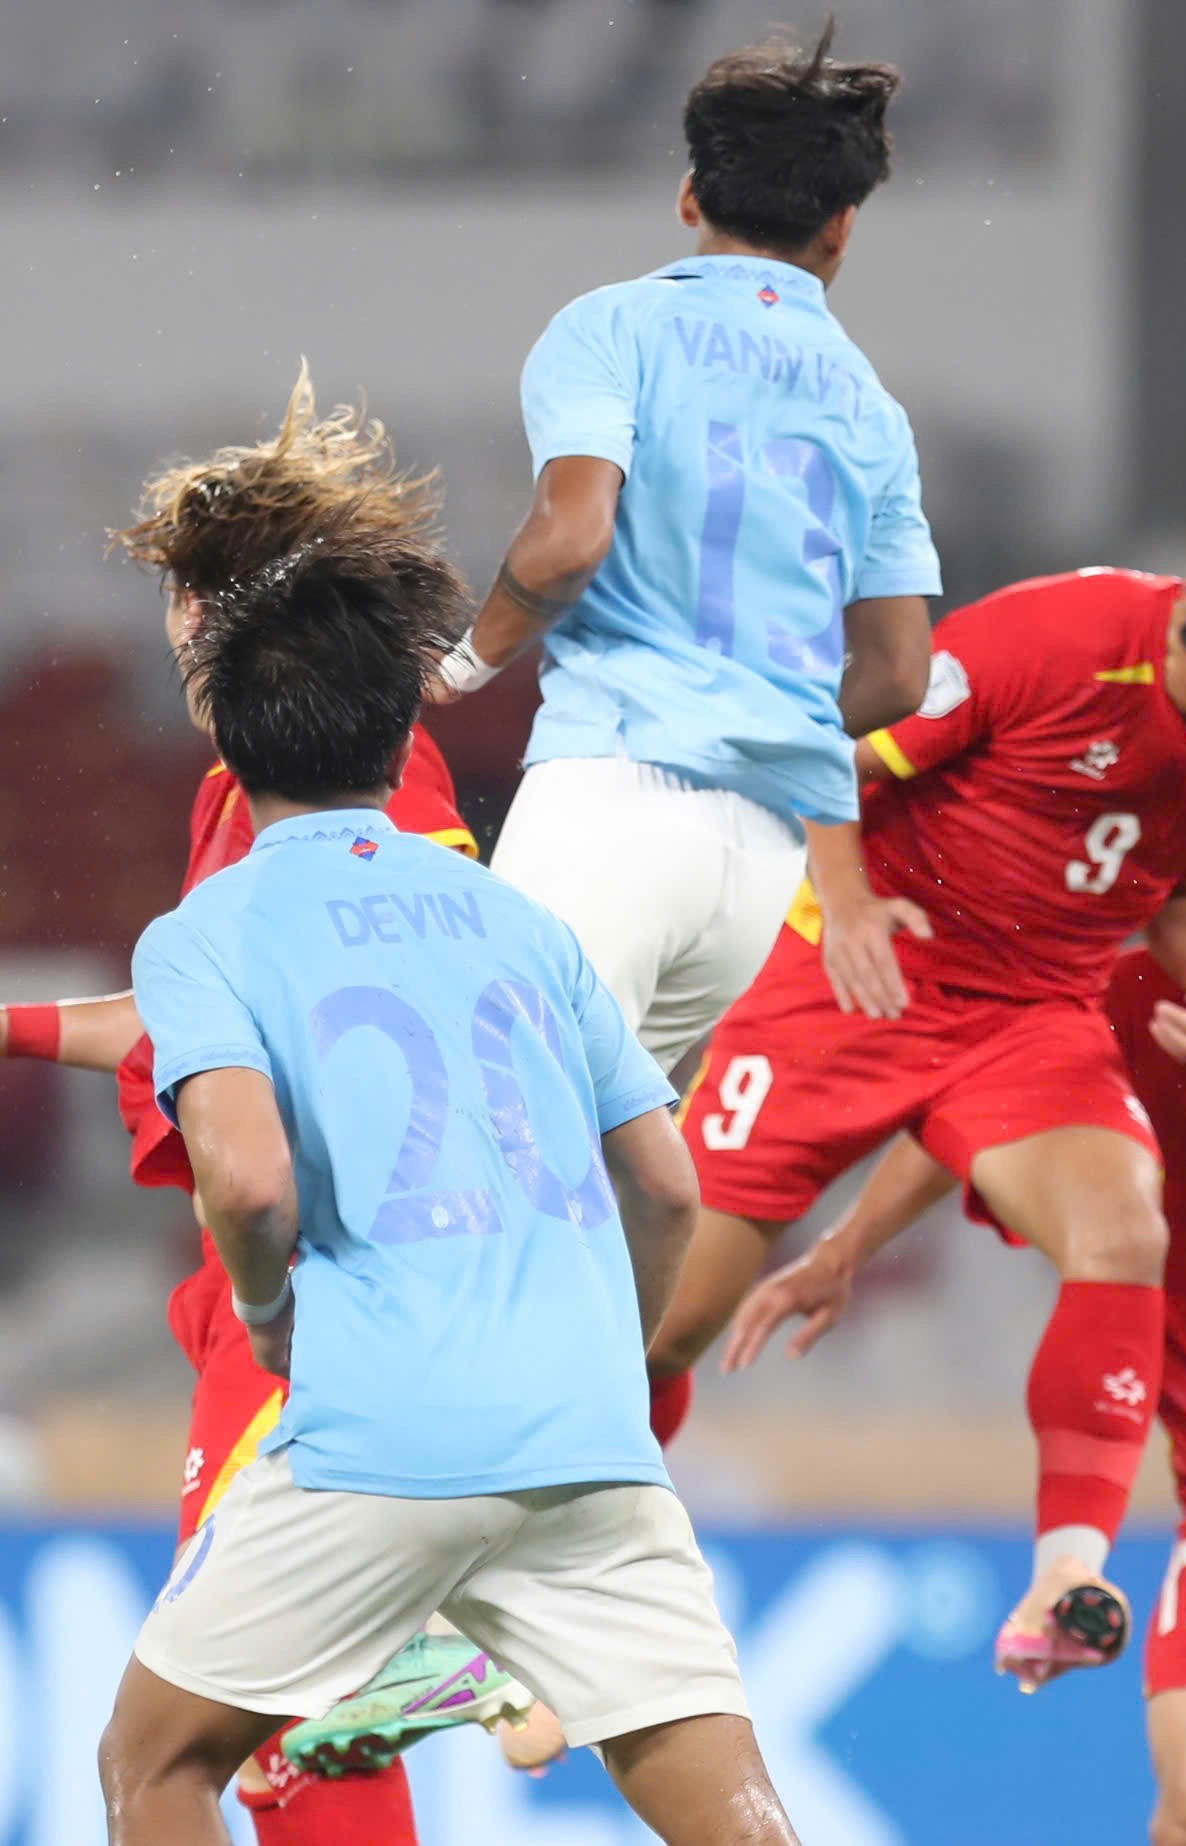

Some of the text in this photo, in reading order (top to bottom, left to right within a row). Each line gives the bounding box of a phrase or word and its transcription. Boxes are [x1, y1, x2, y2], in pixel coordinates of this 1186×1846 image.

[697, 420, 843, 673] 13
[1065, 812, 1141, 895] 9
[325, 890, 488, 948] DEVIN
[309, 978, 617, 1246] 20
[701, 1054, 775, 1151] 9
